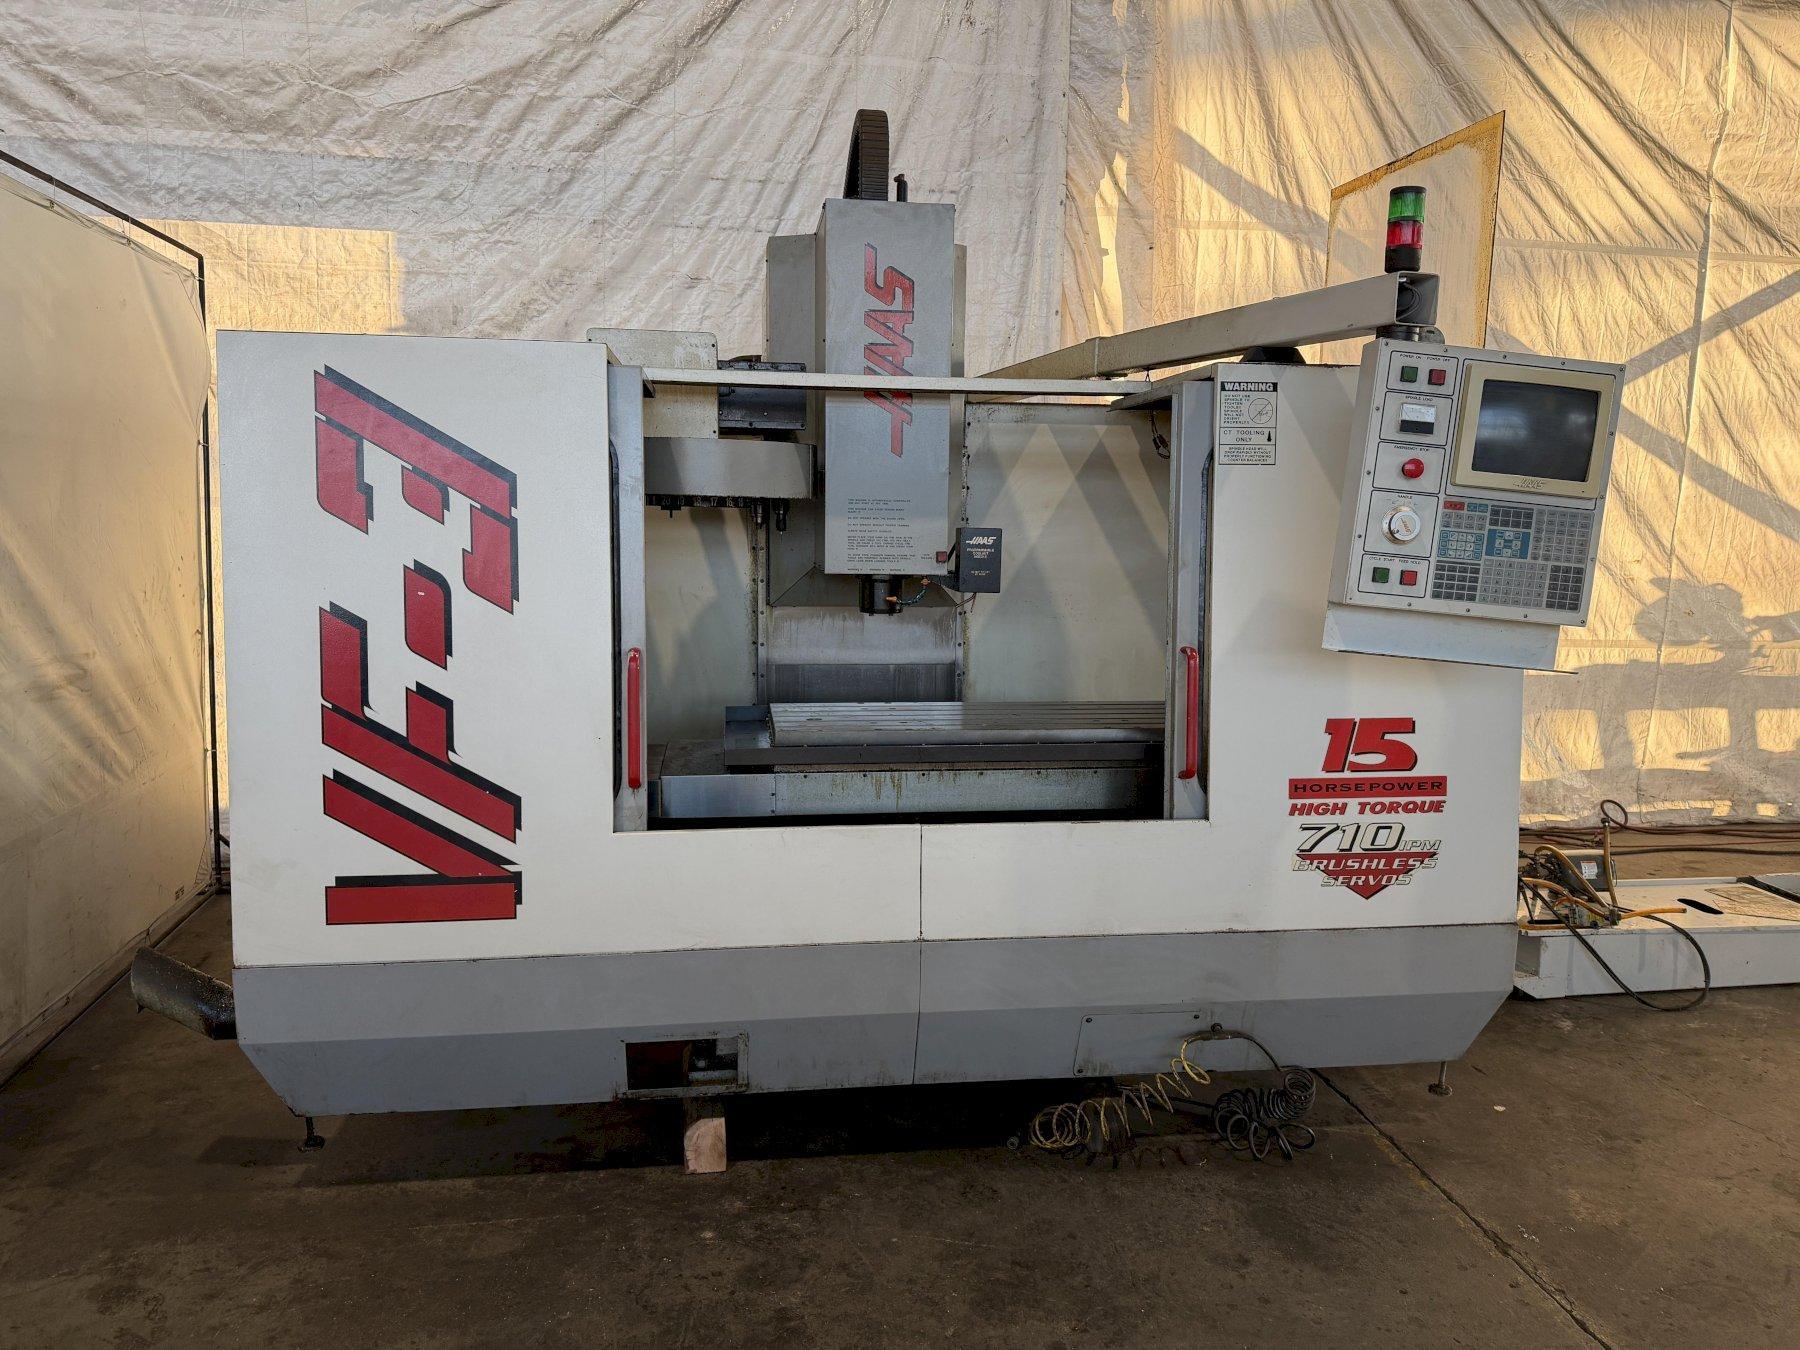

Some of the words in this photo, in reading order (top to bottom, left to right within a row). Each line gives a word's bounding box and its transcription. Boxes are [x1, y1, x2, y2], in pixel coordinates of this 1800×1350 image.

[1224, 382, 1274, 391] WARNING
[966, 537, 996, 545] HAAS
[1322, 717, 1418, 773] 15
[1294, 781, 1443, 793] HORSEPOWER
[1288, 802, 1348, 816] HIGH
[1358, 800, 1446, 815] TORQUE
[1298, 822, 1405, 852] 710
[1292, 857, 1439, 872] BRUSHLESS
[1321, 873, 1413, 887] SERVOS
